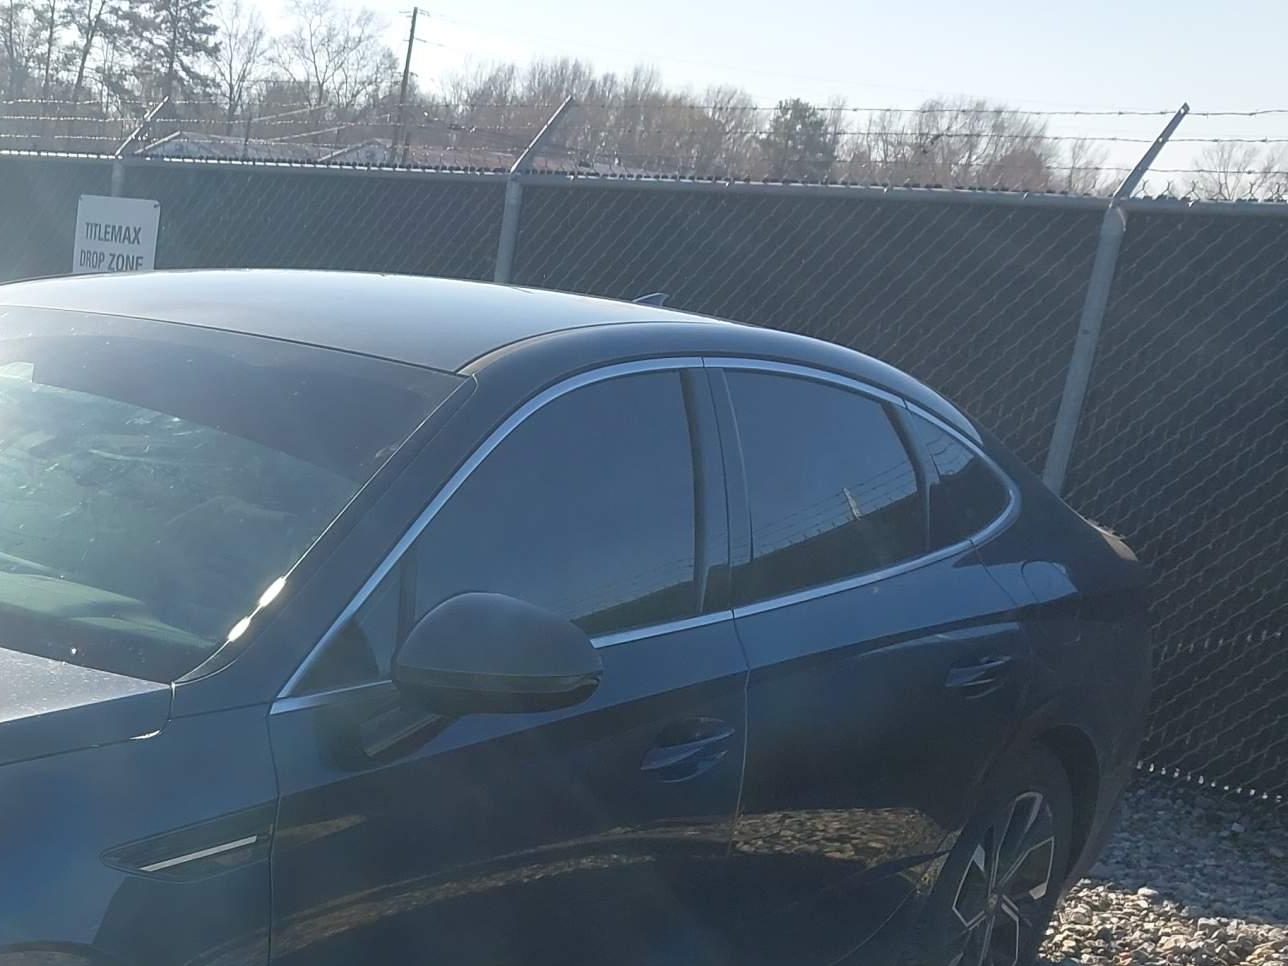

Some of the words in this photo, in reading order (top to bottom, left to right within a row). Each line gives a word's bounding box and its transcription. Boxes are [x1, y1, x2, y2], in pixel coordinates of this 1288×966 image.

[85, 222, 142, 245] TITLEMAX
[79, 249, 105, 269] DROP
[107, 253, 144, 272] ZONE
